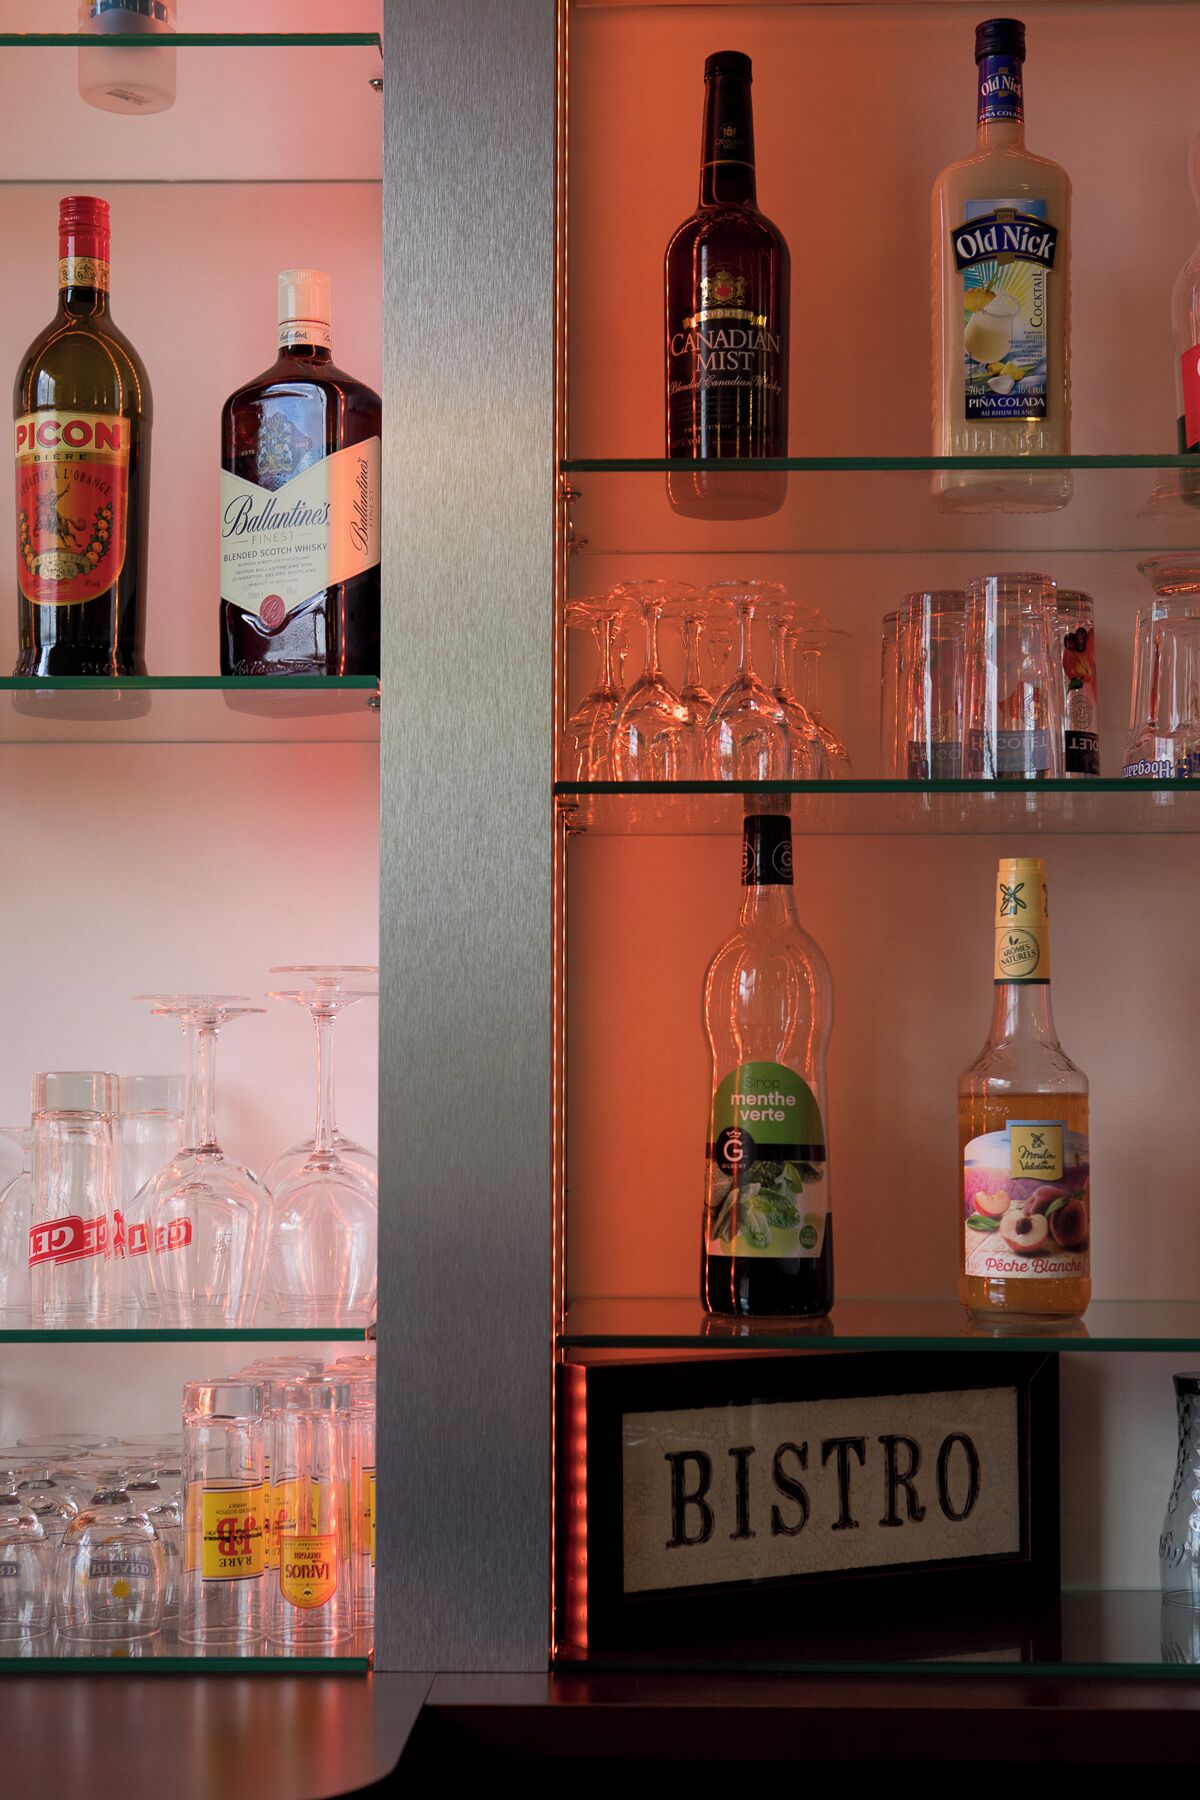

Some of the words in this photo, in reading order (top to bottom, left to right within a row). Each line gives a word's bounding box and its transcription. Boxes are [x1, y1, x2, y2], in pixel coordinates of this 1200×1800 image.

[981, 75, 1000, 97] Old
[956, 227, 998, 260] Old
[1002, 224, 1055, 260] Nick
[1029, 270, 1043, 328] COCKTAIL
[671, 329, 780, 357] CANADIAN
[696, 351, 755, 372] MIST
[704, 374, 752, 388] Canadian
[968, 395, 996, 409] PIÑA
[997, 396, 1046, 408] COLADA
[16, 419, 121, 452] PICON
[63, 468, 112, 497] L'ORANGE
[222, 494, 331, 538] Ballantine's
[350, 457, 369, 556] Ballantine's
[252, 531, 294, 545] FINEST
[223, 550, 258, 563] BLENDED
[260, 546, 292, 558] SCOTCH
[294, 543, 328, 553] WHISKY
[1000, 950, 1037, 965] NATURELS
[745, 1076, 781, 1091] Sirop
[730, 1091, 796, 1107] menthe
[739, 1108, 785, 1121] verte
[723, 1138, 744, 1163] G
[1018, 1145, 1056, 1160] Moulin
[986, 1257, 1029, 1273] Pêche
[1032, 1258, 1083, 1274] Blanche
[665, 1431, 982, 1550] BISTRO
[218, 1556, 252, 1568] RARE
